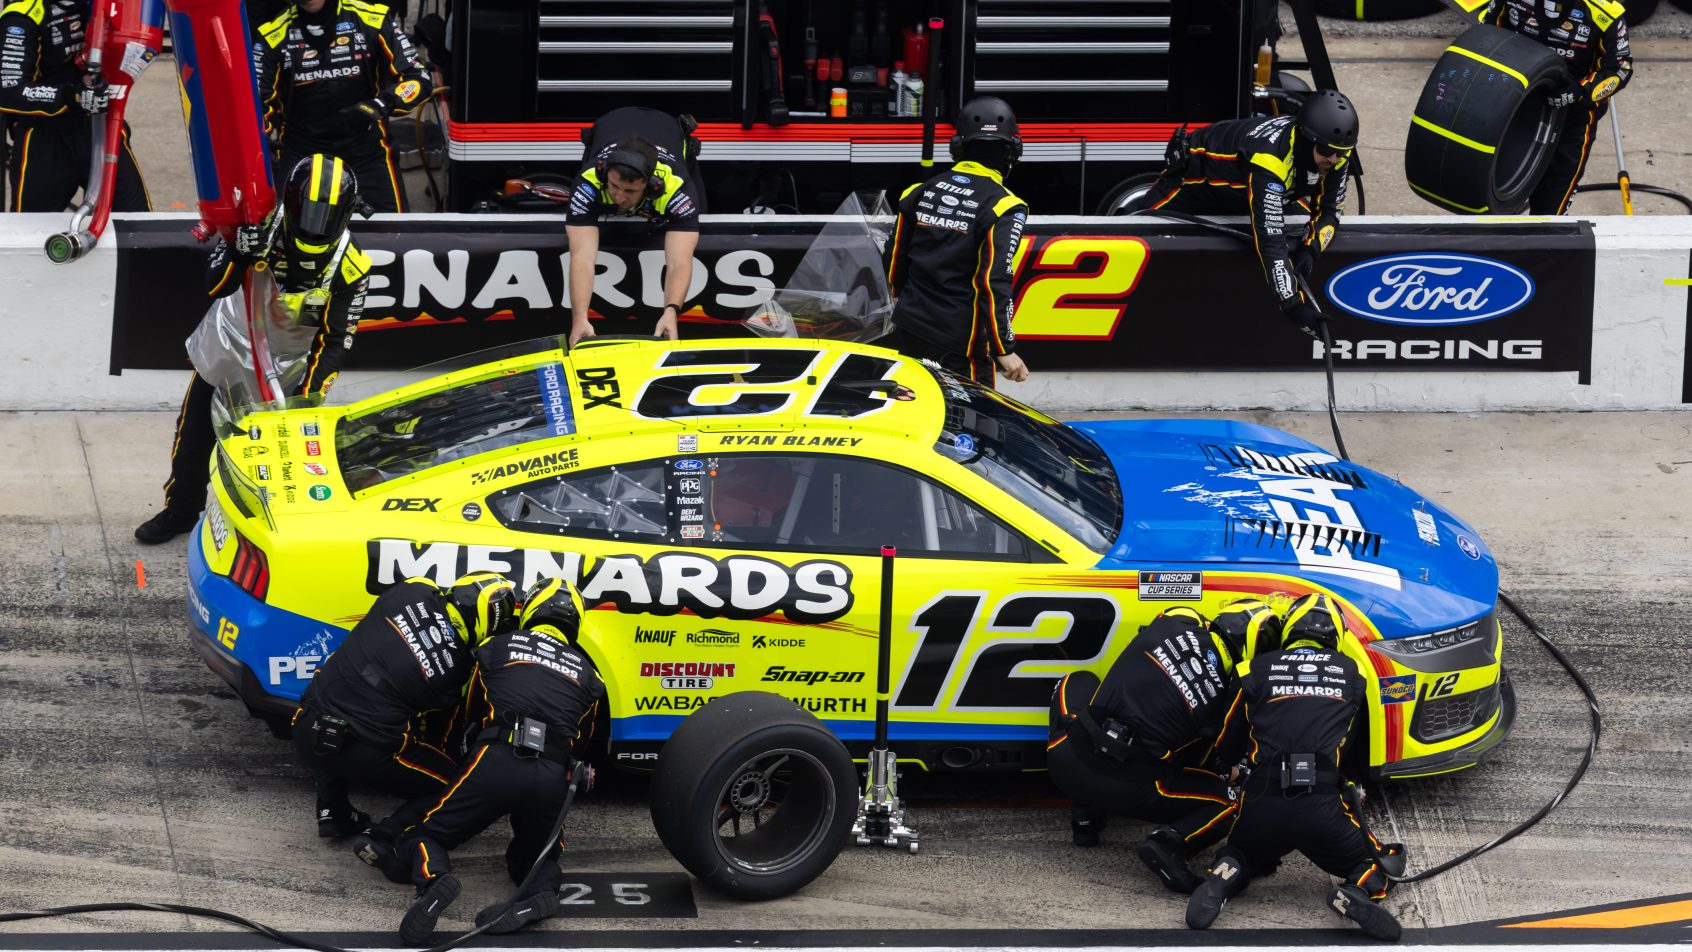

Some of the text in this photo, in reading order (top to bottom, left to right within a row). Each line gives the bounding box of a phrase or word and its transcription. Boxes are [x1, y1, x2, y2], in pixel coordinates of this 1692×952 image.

[294, 66, 361, 82] MENARDS
[574, 191, 589, 204] DEX
[1265, 193, 1282, 202] DEX
[365, 249, 776, 309] ENARDS
[1367, 263, 1489, 312] Ford
[1312, 339, 1543, 360] RACING
[576, 366, 621, 410] DEX
[543, 363, 568, 435] FORD RACING
[719, 435, 864, 447] RYAN BLANEY
[492, 448, 579, 480] ADVANCE
[528, 460, 580, 479] AUTO PARTS
[681, 480, 699, 492] PPG
[381, 498, 443, 513] DEX
[676, 496, 704, 504] Mazak
[1158, 573, 1193, 583] NASCAR
[1147, 585, 1193, 594] CUP SERIES
[216, 616, 240, 651] 12
[433, 611, 458, 649] APSEY
[394, 613, 435, 678] MENARDS
[686, 632, 740, 644] Richmond
[769, 638, 806, 647] KIDDE
[889, 590, 1122, 712] 12
[1280, 653, 1332, 662] FRANCE
[268, 655, 323, 685] PE
[510, 651, 579, 680] MENARDS
[640, 662, 736, 677] DISCOUNT
[666, 679, 708, 687] TIRE
[760, 665, 866, 686] Snap-on
[1154, 646, 1198, 709] MENARDS
[1272, 685, 1343, 697] MENARDS
[1381, 685, 1415, 695] SUNOCO
[1428, 672, 1460, 698] 12
[634, 696, 720, 711] WABA
[617, 752, 659, 760] FOR
